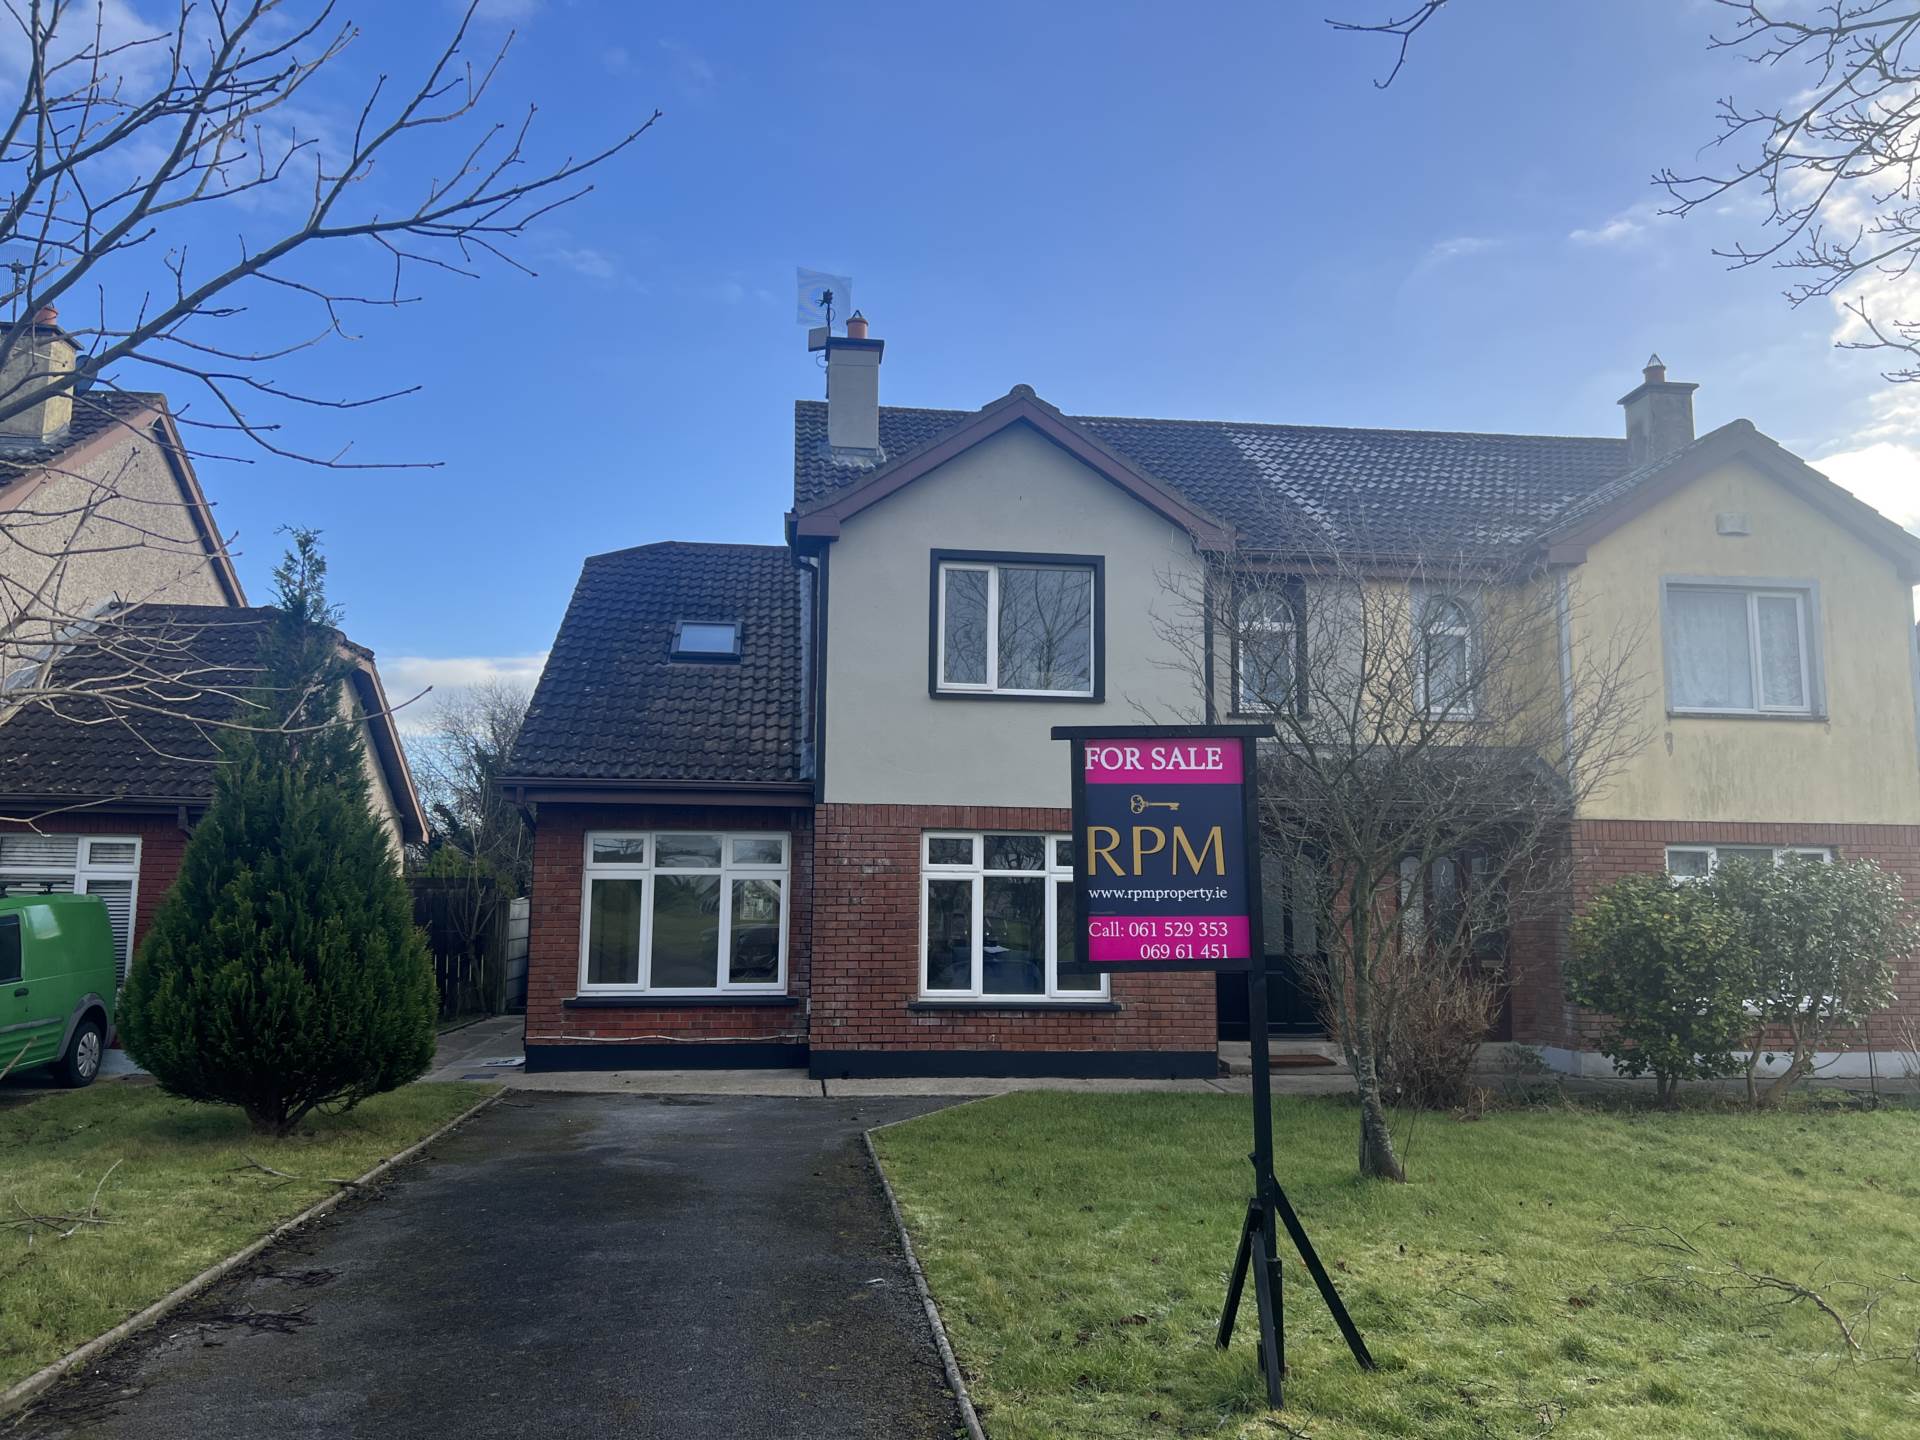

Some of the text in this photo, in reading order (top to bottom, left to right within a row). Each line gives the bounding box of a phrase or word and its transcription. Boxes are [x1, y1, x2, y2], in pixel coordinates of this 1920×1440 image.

[1085, 747, 1223, 770] FOR SALE
[1087, 826, 1226, 876] RPM
[1088, 887, 1228, 901] www.rpmproperty.ie
[1088, 922, 1228, 937] Call: 061 529 353
[1140, 944, 1229, 959] 069 61 451
